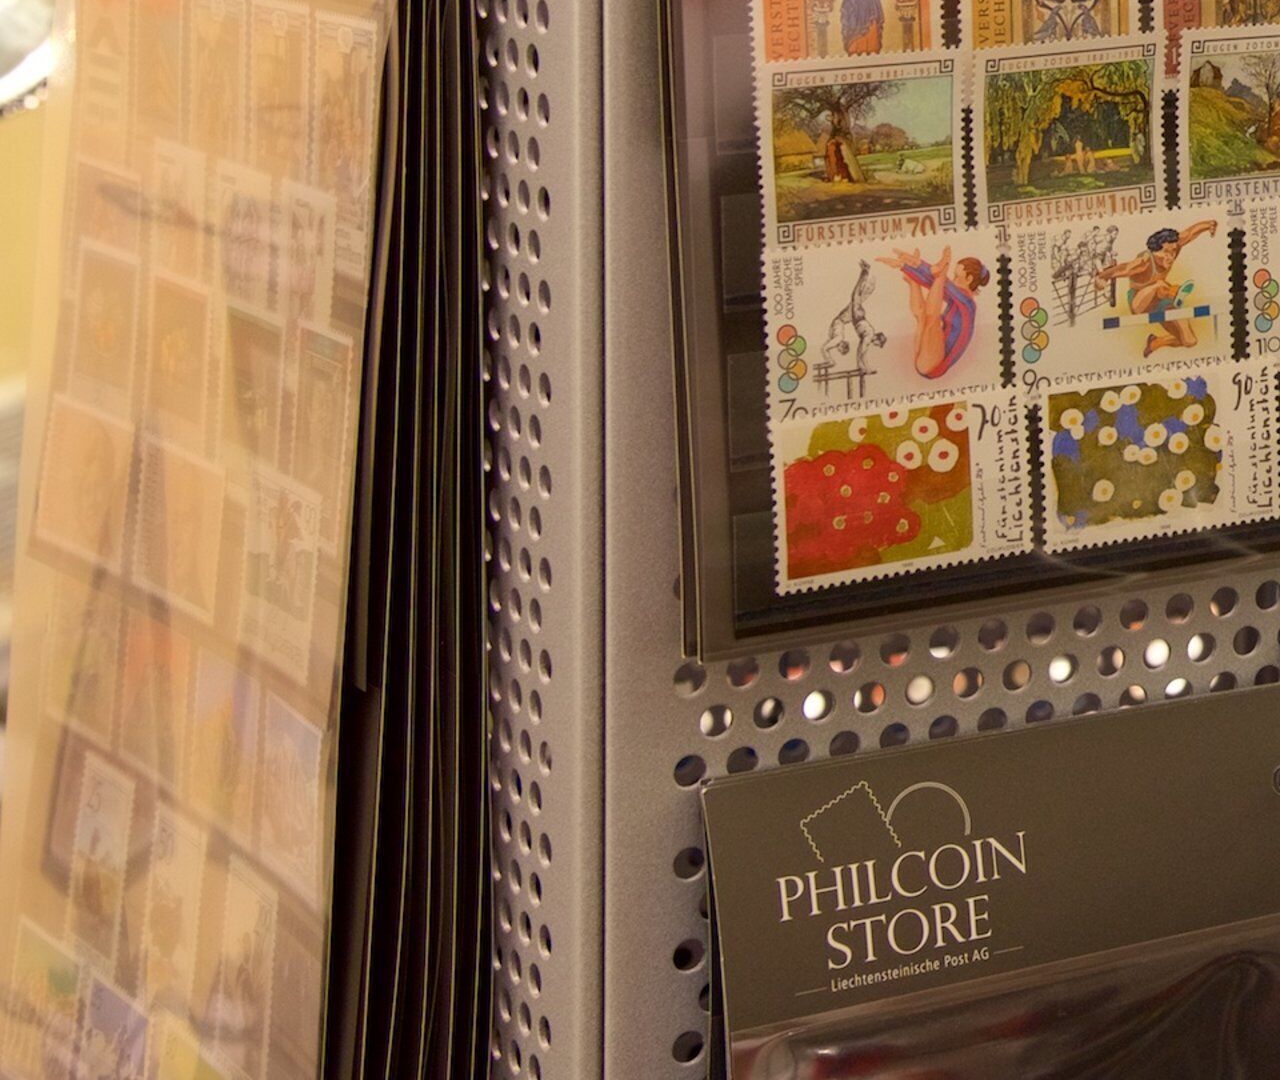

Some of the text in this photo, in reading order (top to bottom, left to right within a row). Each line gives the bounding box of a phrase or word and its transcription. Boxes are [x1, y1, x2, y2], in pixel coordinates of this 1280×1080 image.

[1042, 56, 1080, 69] ZOTOW
[1246, 40, 1280, 51] ZOTOW
[833, 71, 872, 83] ZOTOW
[1006, 195, 1106, 219] FÜRSTENTUM
[1250, 208, 1258, 238] JAHRE
[796, 215, 936, 242] FÜRSTENTUM 70
[1018, 233, 1026, 263] JAHRE
[1259, 207, 1269, 265] OLYMPISCHE
[774, 258, 782, 291] JAHRE
[1028, 232, 1038, 292] OLYMPISCHE
[784, 257, 795, 320] OLYMPISCHE
[1256, 366, 1273, 508] Liechtenstein
[1003, 394, 1024, 543] Liechtenstein
[776, 830, 1027, 922] PHILCOIN
[826, 894, 992, 971] STORE
[831, 946, 990, 992] Liechtensteinische Post AG
